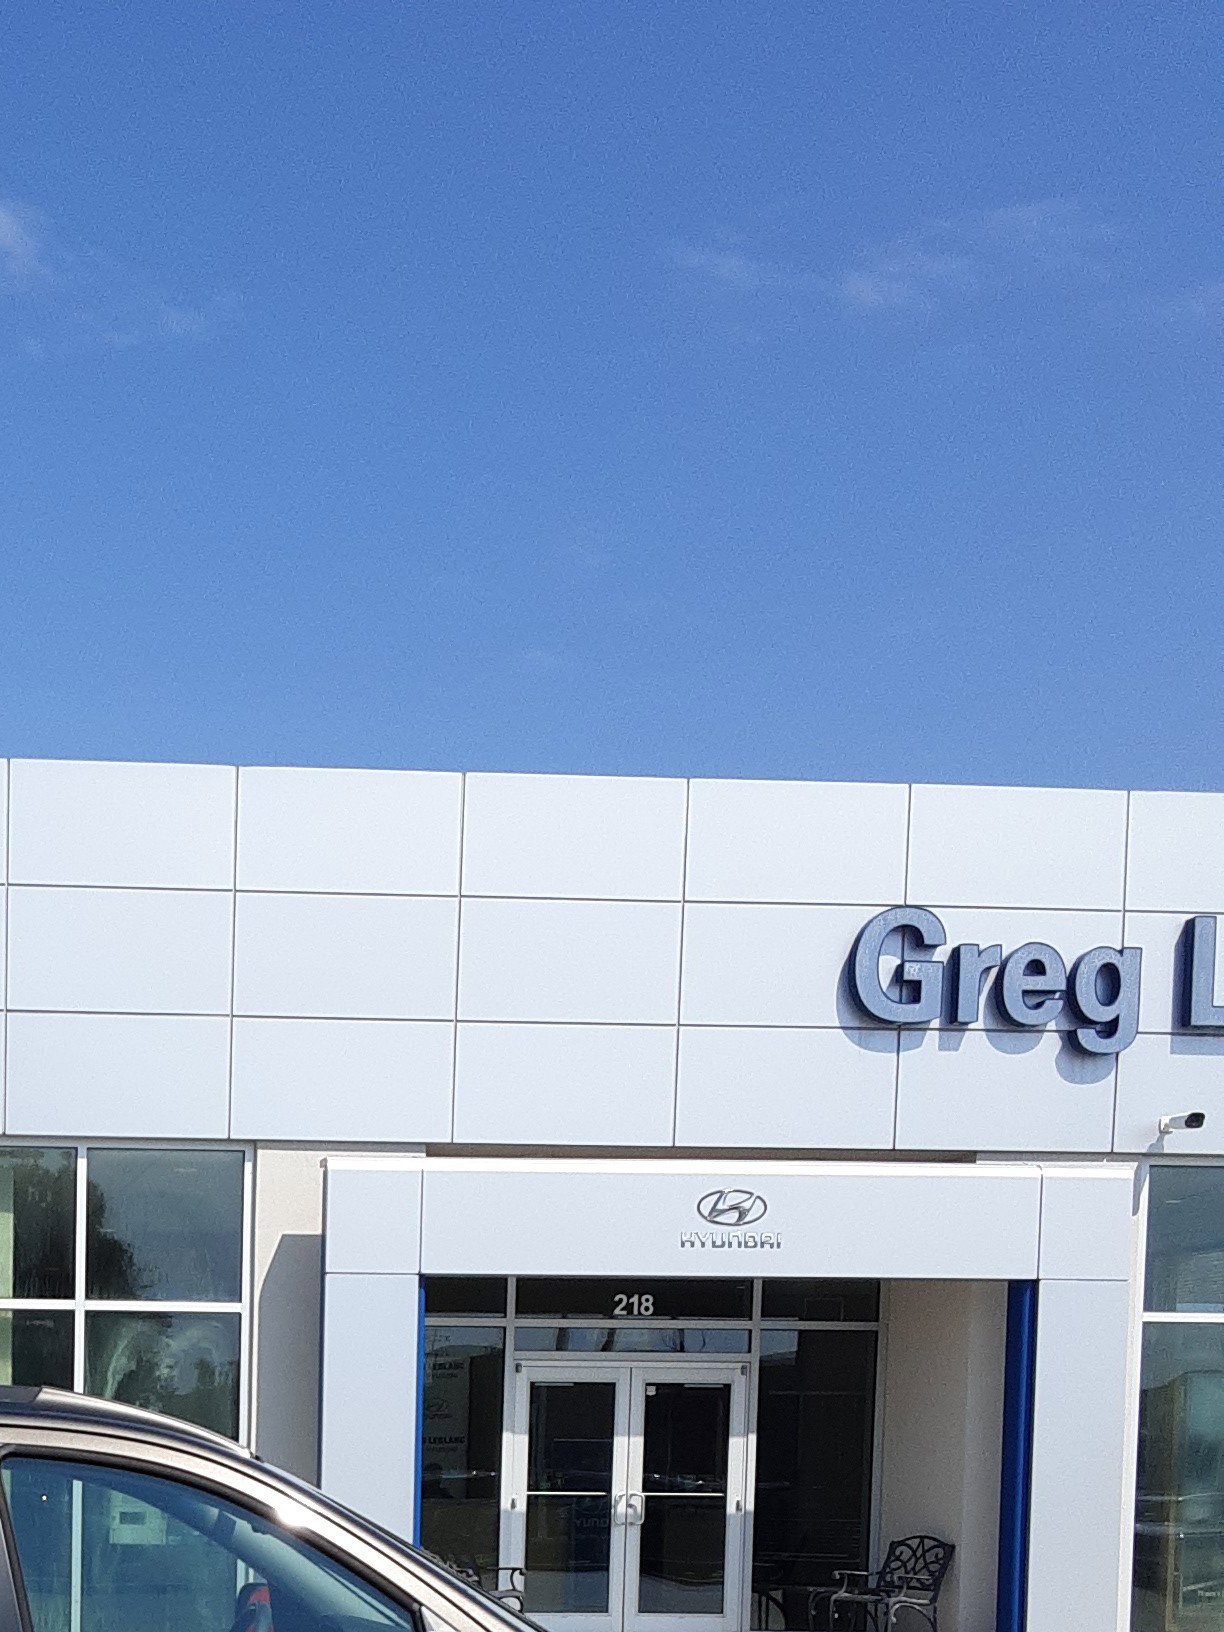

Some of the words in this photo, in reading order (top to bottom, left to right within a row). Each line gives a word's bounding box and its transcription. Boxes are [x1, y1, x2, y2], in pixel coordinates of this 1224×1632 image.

[848, 904, 1143, 1056] Greg
[680, 1231, 782, 1249] HYUNDAI
[613, 1293, 654, 1316] 218
